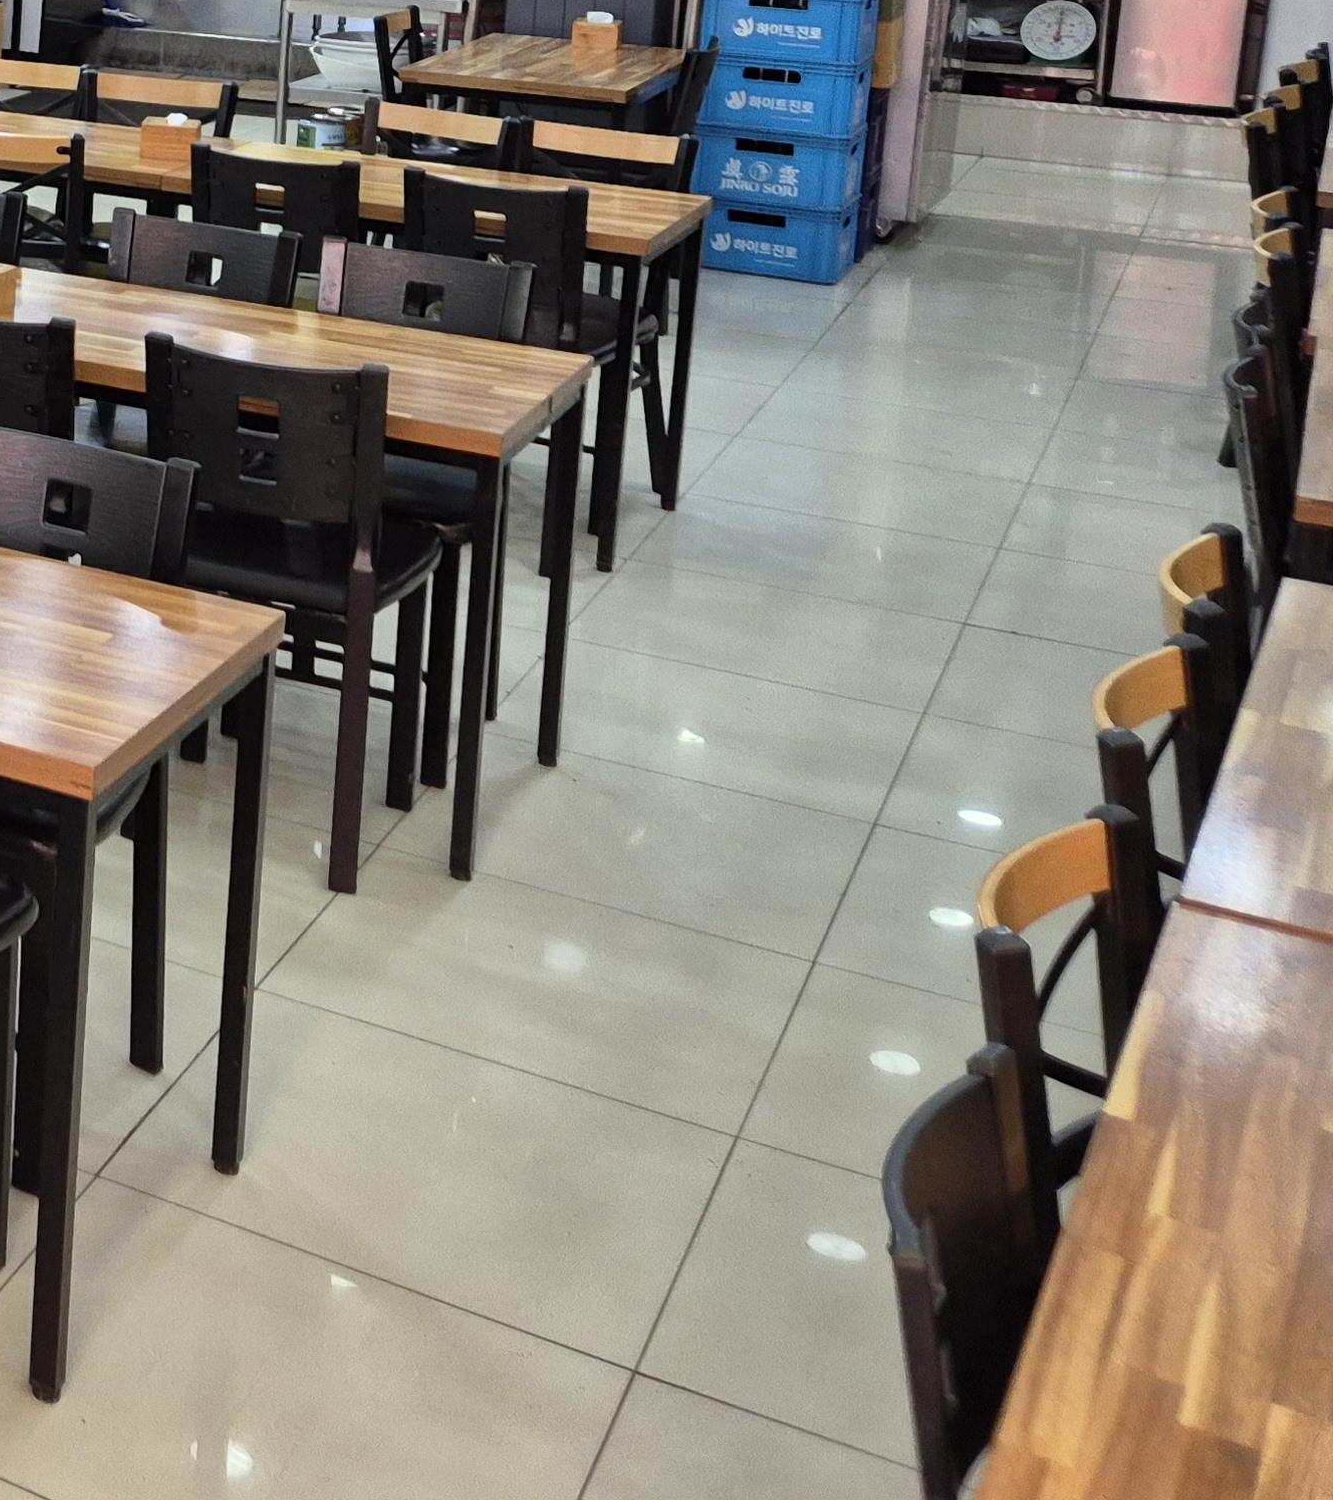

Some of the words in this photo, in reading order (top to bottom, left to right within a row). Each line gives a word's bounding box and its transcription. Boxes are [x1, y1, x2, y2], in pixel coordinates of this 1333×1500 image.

[756, 22, 823, 40] 하이트진로
[748, 95, 815, 115] 하이트진로
[719, 178, 760, 192] JINRO
[762, 183, 799, 198] SOJU
[733, 238, 799, 260] 하이트진로
